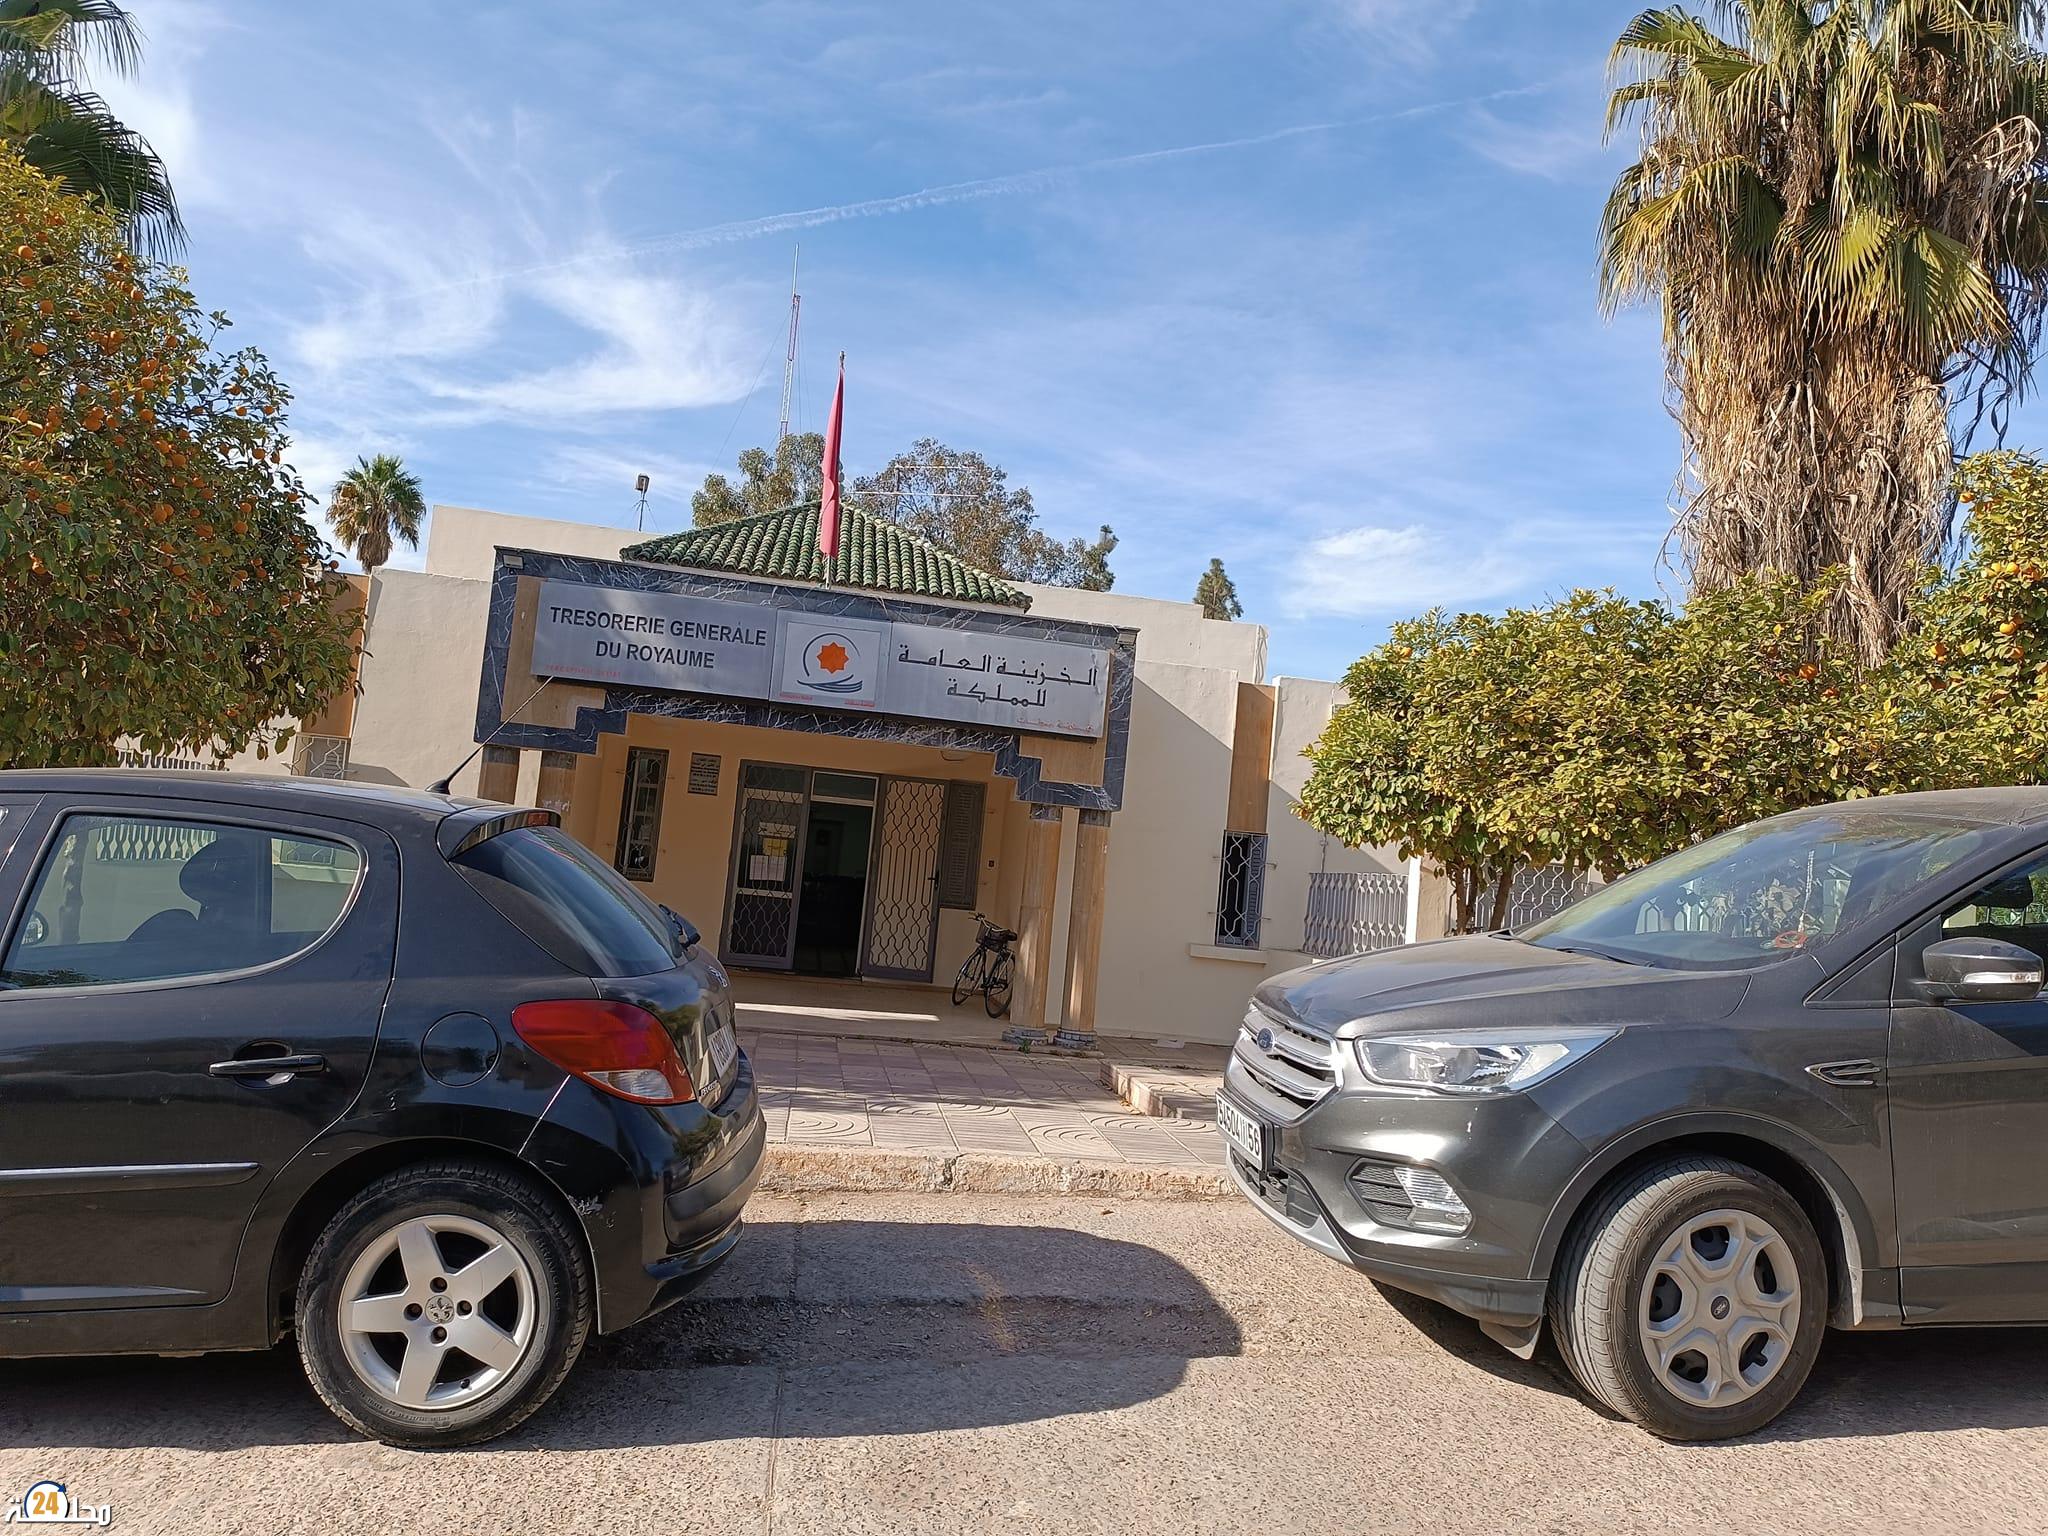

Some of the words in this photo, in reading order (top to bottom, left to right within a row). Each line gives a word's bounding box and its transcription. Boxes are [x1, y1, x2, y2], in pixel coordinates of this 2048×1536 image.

[550, 606, 665, 634] TRESORERIE
[670, 620, 768, 646] GENERALE
[595, 640, 621, 659] DU
[626, 644, 715, 669] ROYAUME
[898, 644, 991, 673] العامة
[996, 657, 1098, 686] الخزينة
[947, 678, 1047, 707] للمملكة
